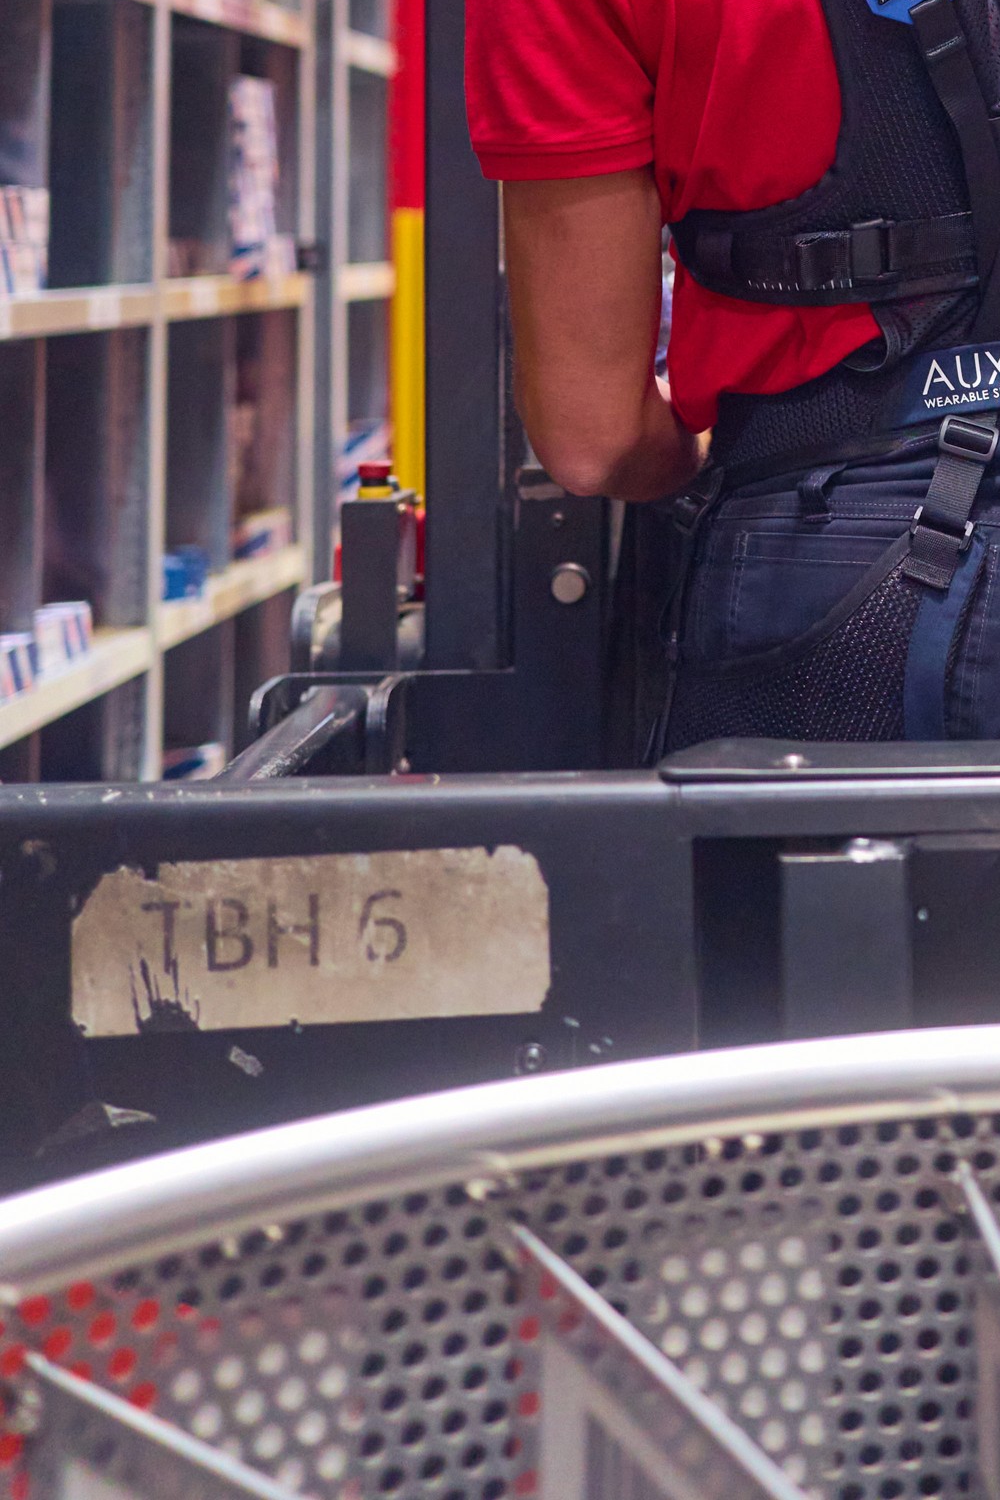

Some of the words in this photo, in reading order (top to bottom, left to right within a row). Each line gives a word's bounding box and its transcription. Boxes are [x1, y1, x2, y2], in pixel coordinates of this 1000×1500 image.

[923, 389, 990, 409] WEARABLE
[140, 893, 320, 974] TBH
[358, 888, 408, 963] 6
